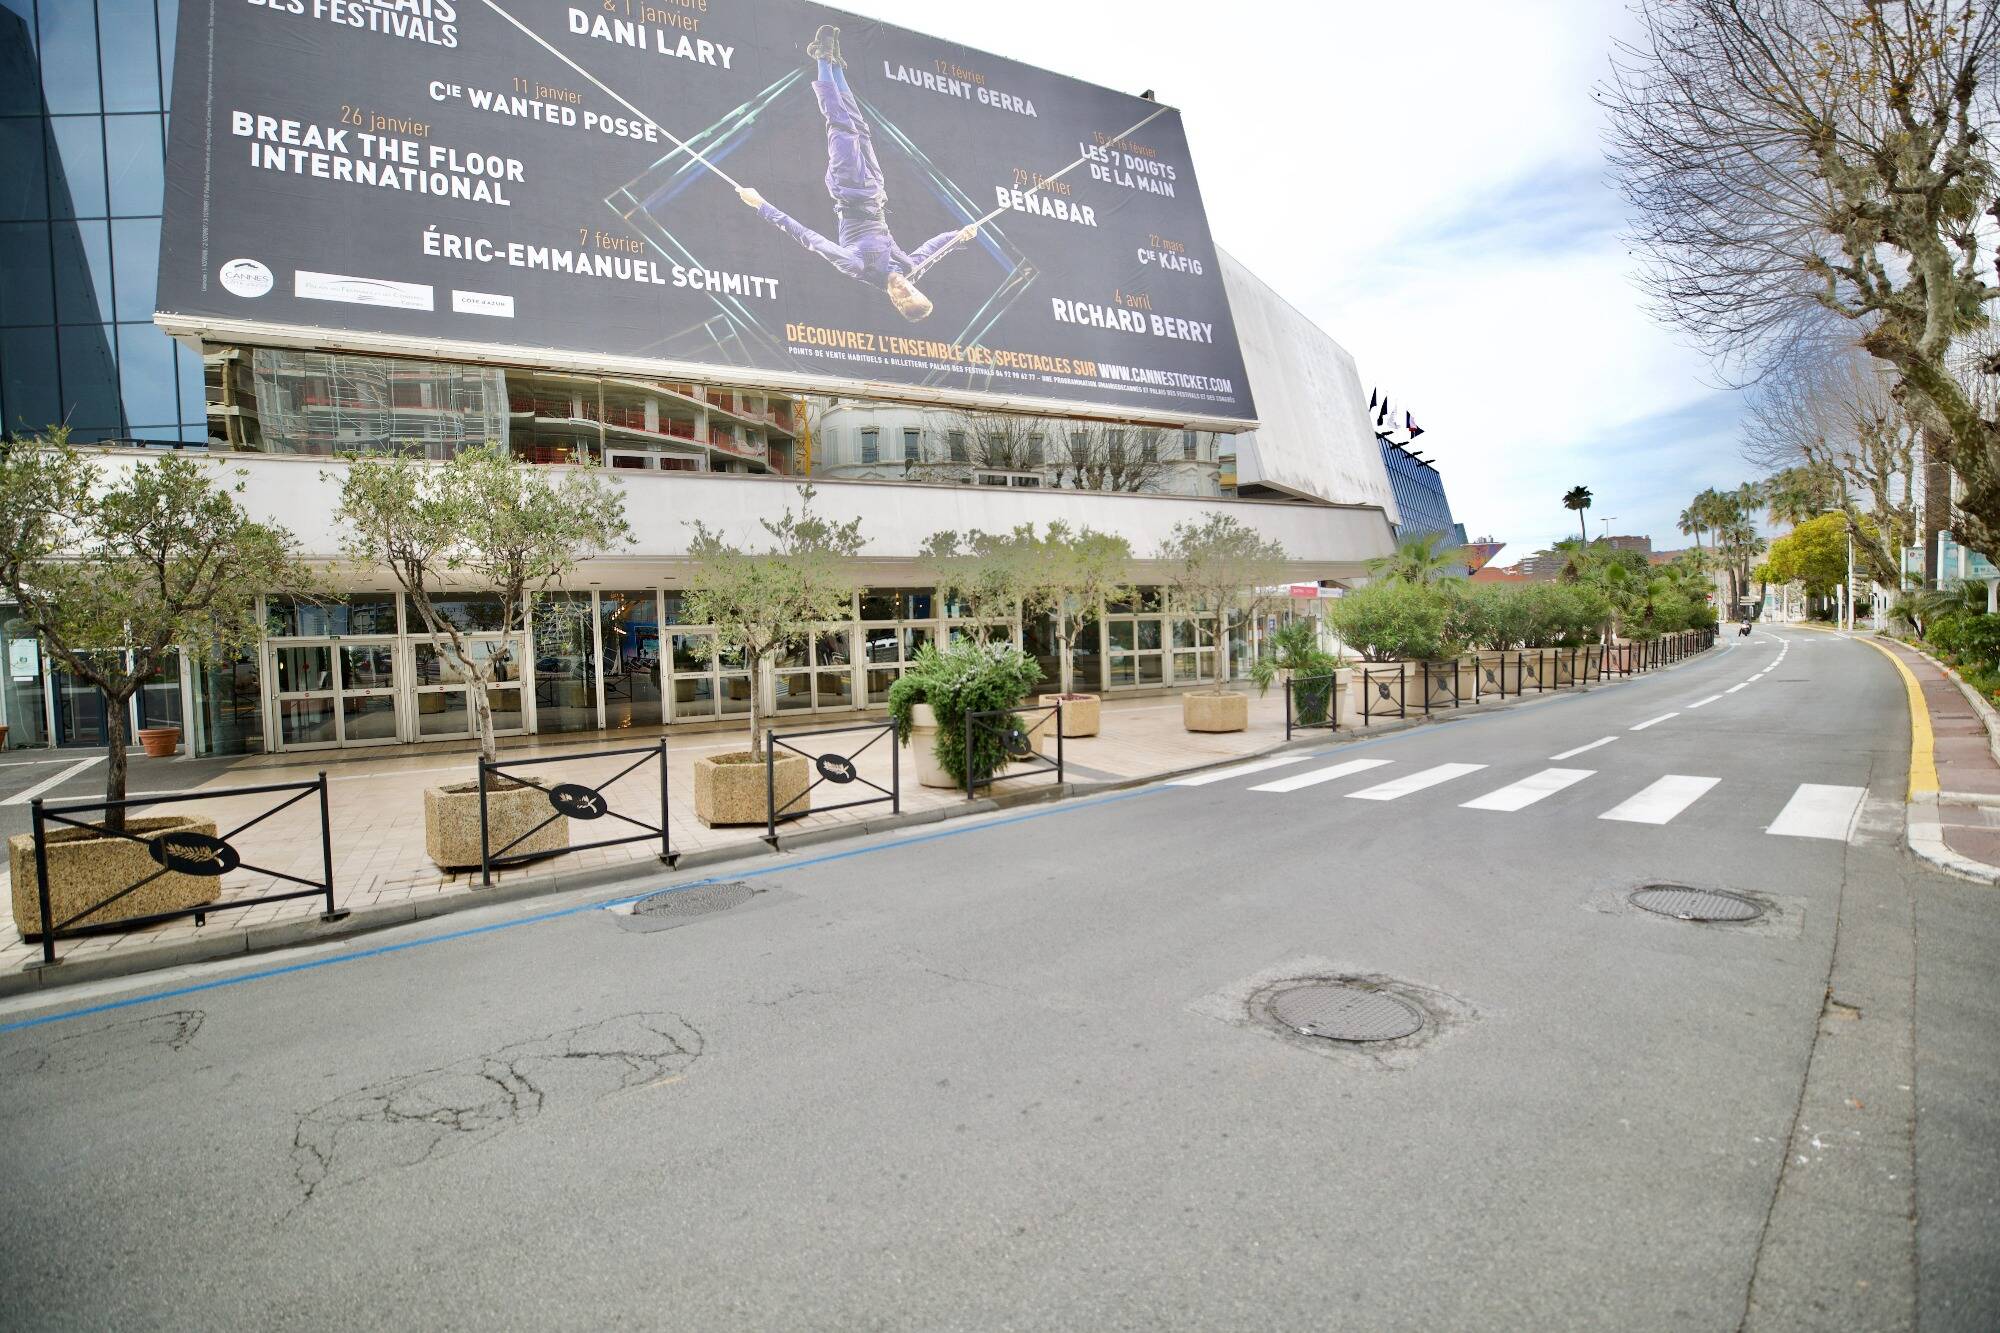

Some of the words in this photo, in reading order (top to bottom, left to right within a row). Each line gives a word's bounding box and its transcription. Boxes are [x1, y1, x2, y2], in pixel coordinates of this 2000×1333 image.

[313, 0, 458, 48] FESTIVALS
[641, 1, 700, 32] janvier
[568, 7, 647, 50] DANI
[656, 29, 735, 70] LARY
[883, 60, 972, 100] LAURENT
[977, 86, 1038, 118] GERRA
[934, 59, 948, 75] 12
[951, 64, 986, 85] février
[513, 77, 528, 94] 11
[535, 82, 584, 105] janvier
[341, 105, 362, 126] 26
[369, 111, 431, 138] janvier
[467, 87, 577, 128] WANTED
[584, 110, 658, 143] POSSE
[232, 110, 350, 154] BREAK
[357, 132, 420, 166] THE
[429, 145, 525, 183] FLOOR
[1079, 142, 1109, 165] LES
[1111, 150, 1120, 166] 7
[1123, 154, 1177, 181] DOIGTS
[251, 142, 511, 207] INTERNATIONAL
[1013, 168, 1028, 186] 29
[1032, 172, 1072, 196] février
[1089, 163, 1112, 183] DE
[1113, 169, 1135, 189] LA
[1136, 175, 1176, 198] MAIN
[995, 183, 1098, 228] BÉNABAR
[579, 228, 588, 246] 7
[595, 231, 645, 255] février
[1149, 233, 1160, 248] 22
[1163, 238, 1185, 253] mars
[225, 271, 269, 282] CANNES
[423, 224, 666, 285] ÉRIC-EMMANUEL
[672, 265, 779, 300] SCHMITT
[1158, 251, 1203, 276] KÄFIG
[1114, 288, 1122, 305] 4
[1126, 293, 1153, 311] avril
[1051, 297, 1147, 335] RICHARD
[1150, 314, 1213, 344] BERRY
[786, 322, 876, 351] DÉCOUVREZ
[879, 335, 964, 361] L'ENSEMBLE
[967, 344, 992, 365] DES
[995, 350, 1072, 374] SPECTACLES
[1073, 360, 1097, 377] SUR
[1098, 362, 1233, 394] WWW.CANNESTICKET.COM
[788, 346, 813, 357] POINTS
[815, 349, 823, 358] DE
[826, 350, 846, 360] VENTE
[848, 353, 883, 364] HABITUELS
[891, 358, 929, 370] BILLETTERIE
[930, 362, 951, 372] PALAIS
